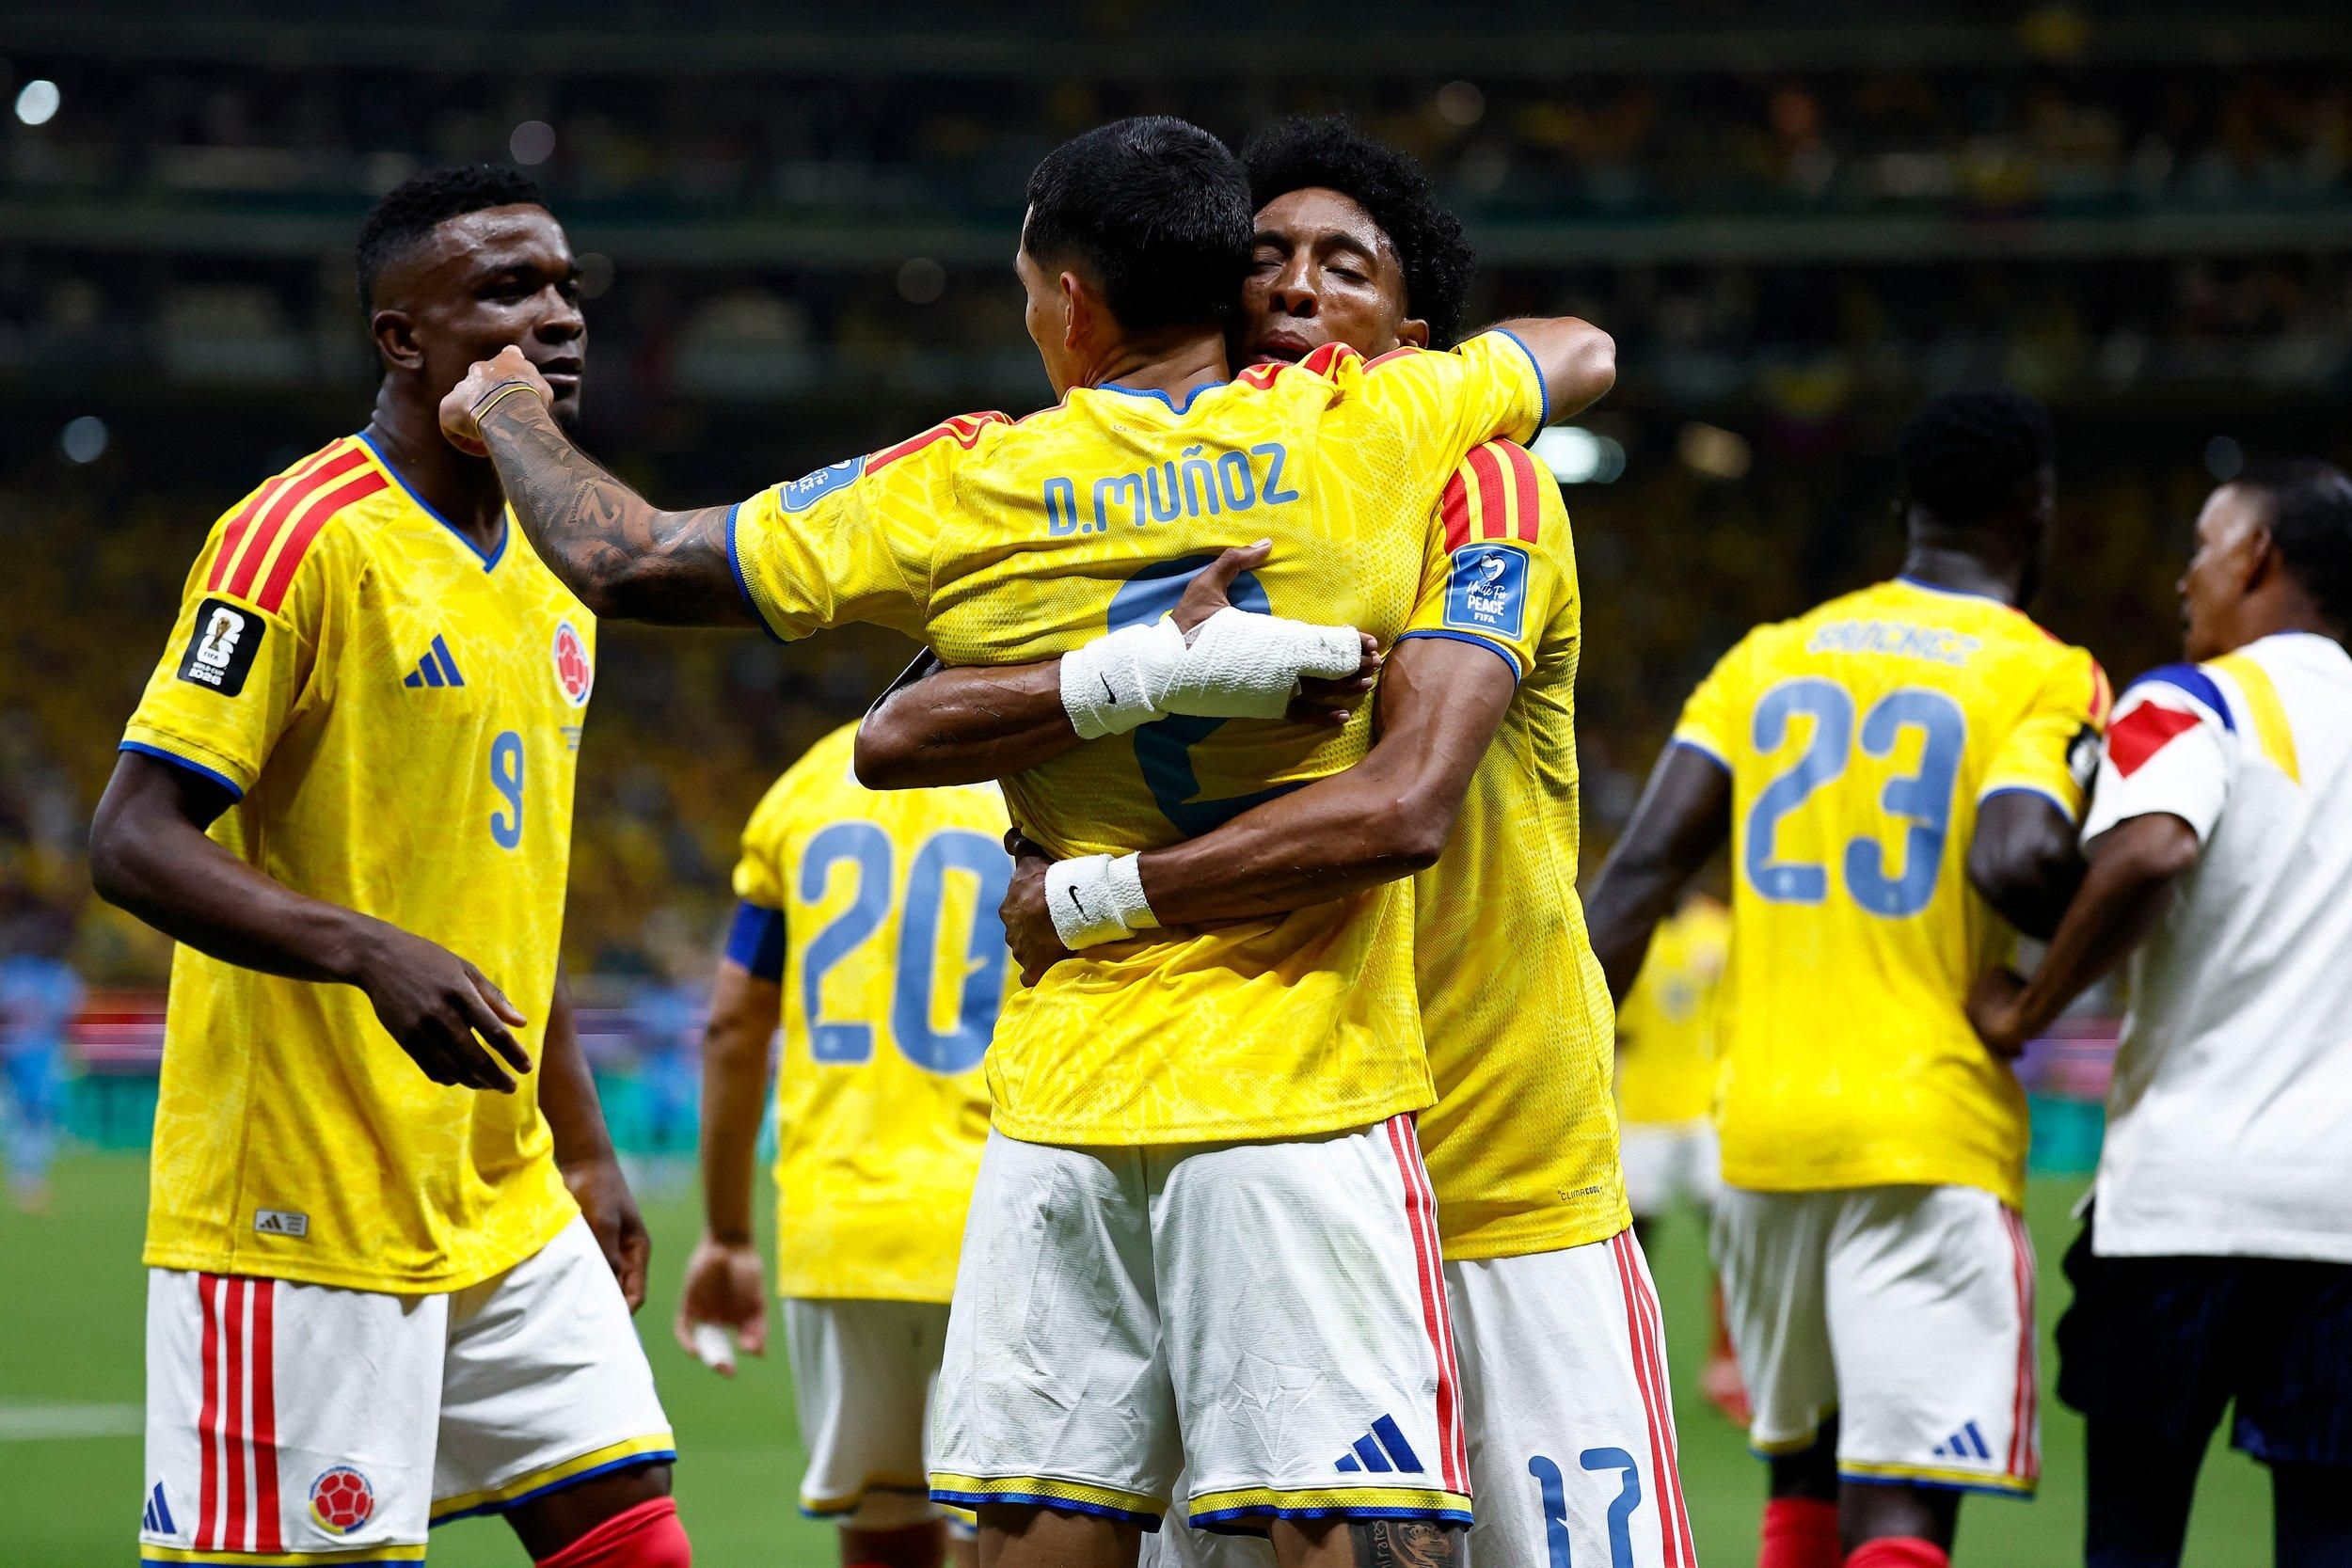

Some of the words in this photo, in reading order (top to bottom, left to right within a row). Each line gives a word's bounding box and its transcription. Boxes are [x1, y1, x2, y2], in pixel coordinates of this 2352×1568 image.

[1043, 442, 1299, 537] D.MUÑOZ
[1468, 594, 1505, 616] PEACE
[1474, 612, 1496, 624] FIFA
[490, 730, 524, 850] 9
[1745, 676, 1965, 919] 23
[798, 816, 1014, 1074] 20
[1528, 1447, 1642, 1568] 17
